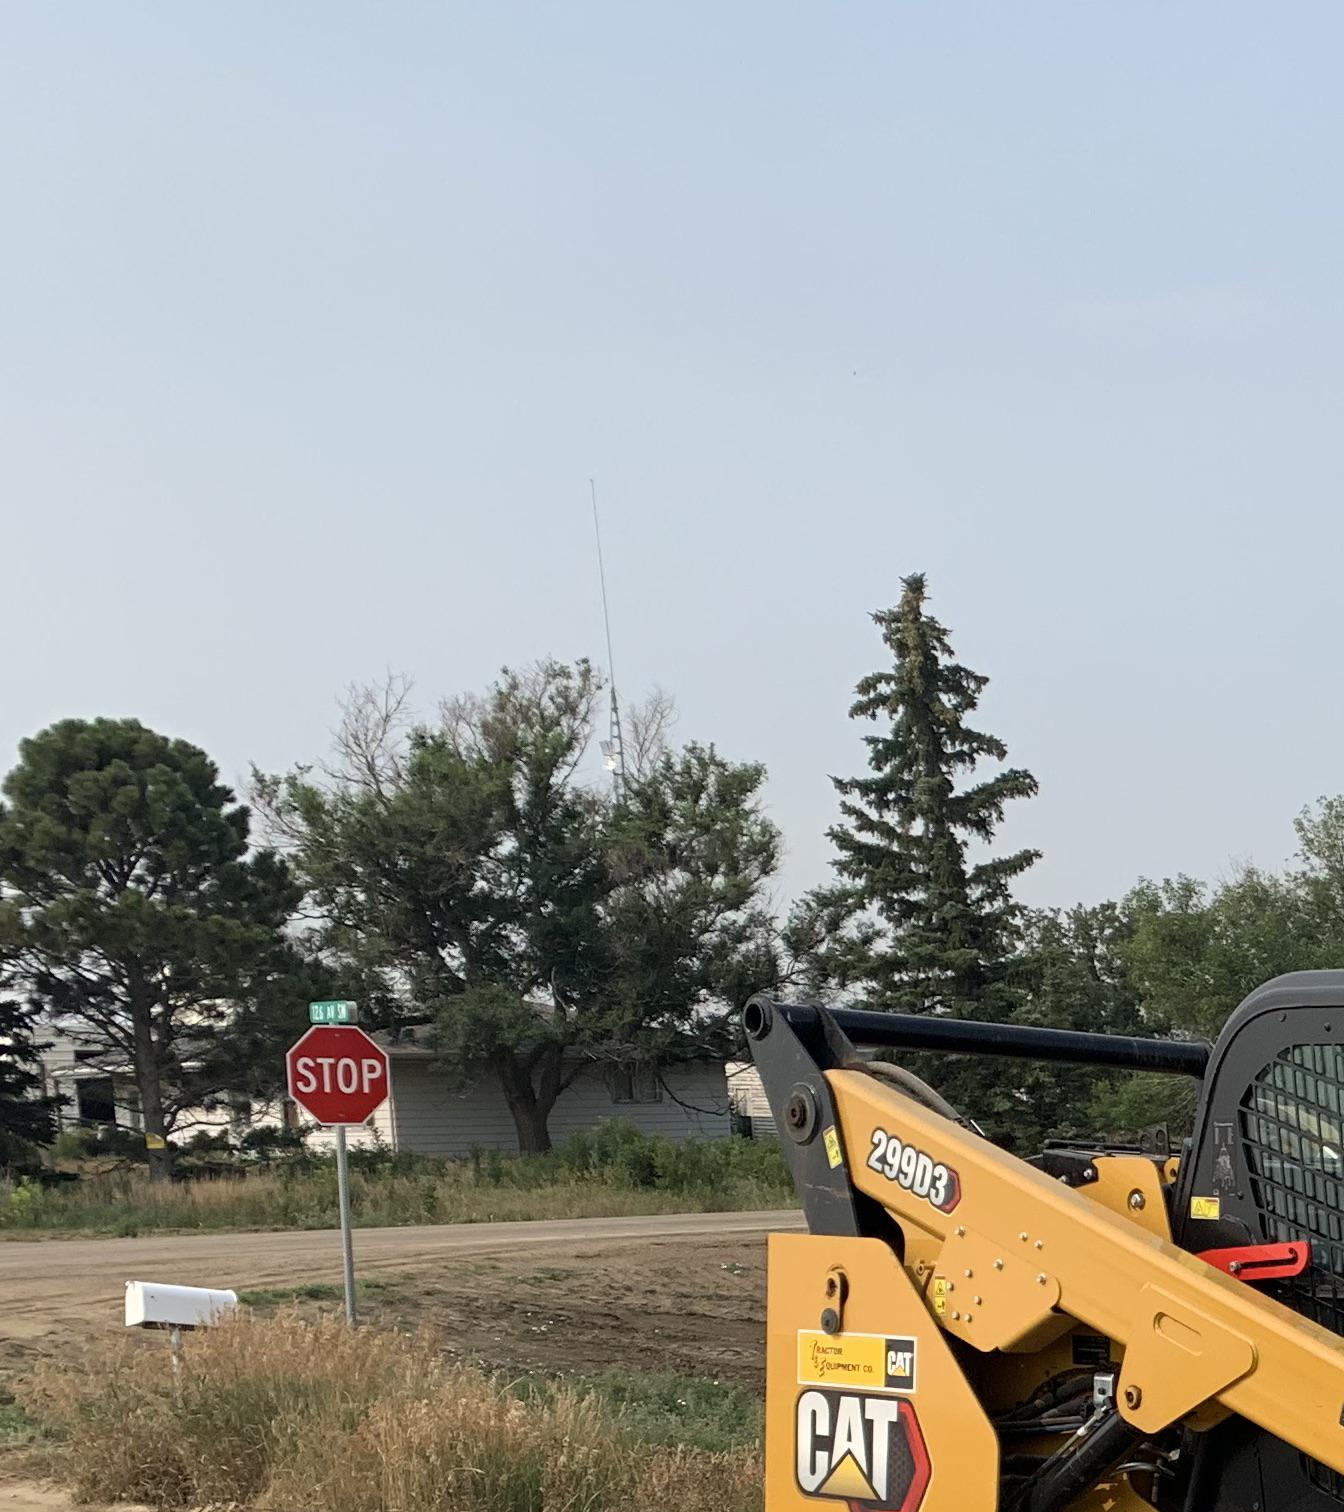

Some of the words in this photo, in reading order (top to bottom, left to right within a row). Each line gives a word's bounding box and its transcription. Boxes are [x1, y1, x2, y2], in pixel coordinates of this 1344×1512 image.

[296, 1057, 382, 1094] STOP
[867, 1128, 948, 1206] 299D3
[887, 1350, 913, 1376] CAT
[797, 1391, 898, 1501] CAT
